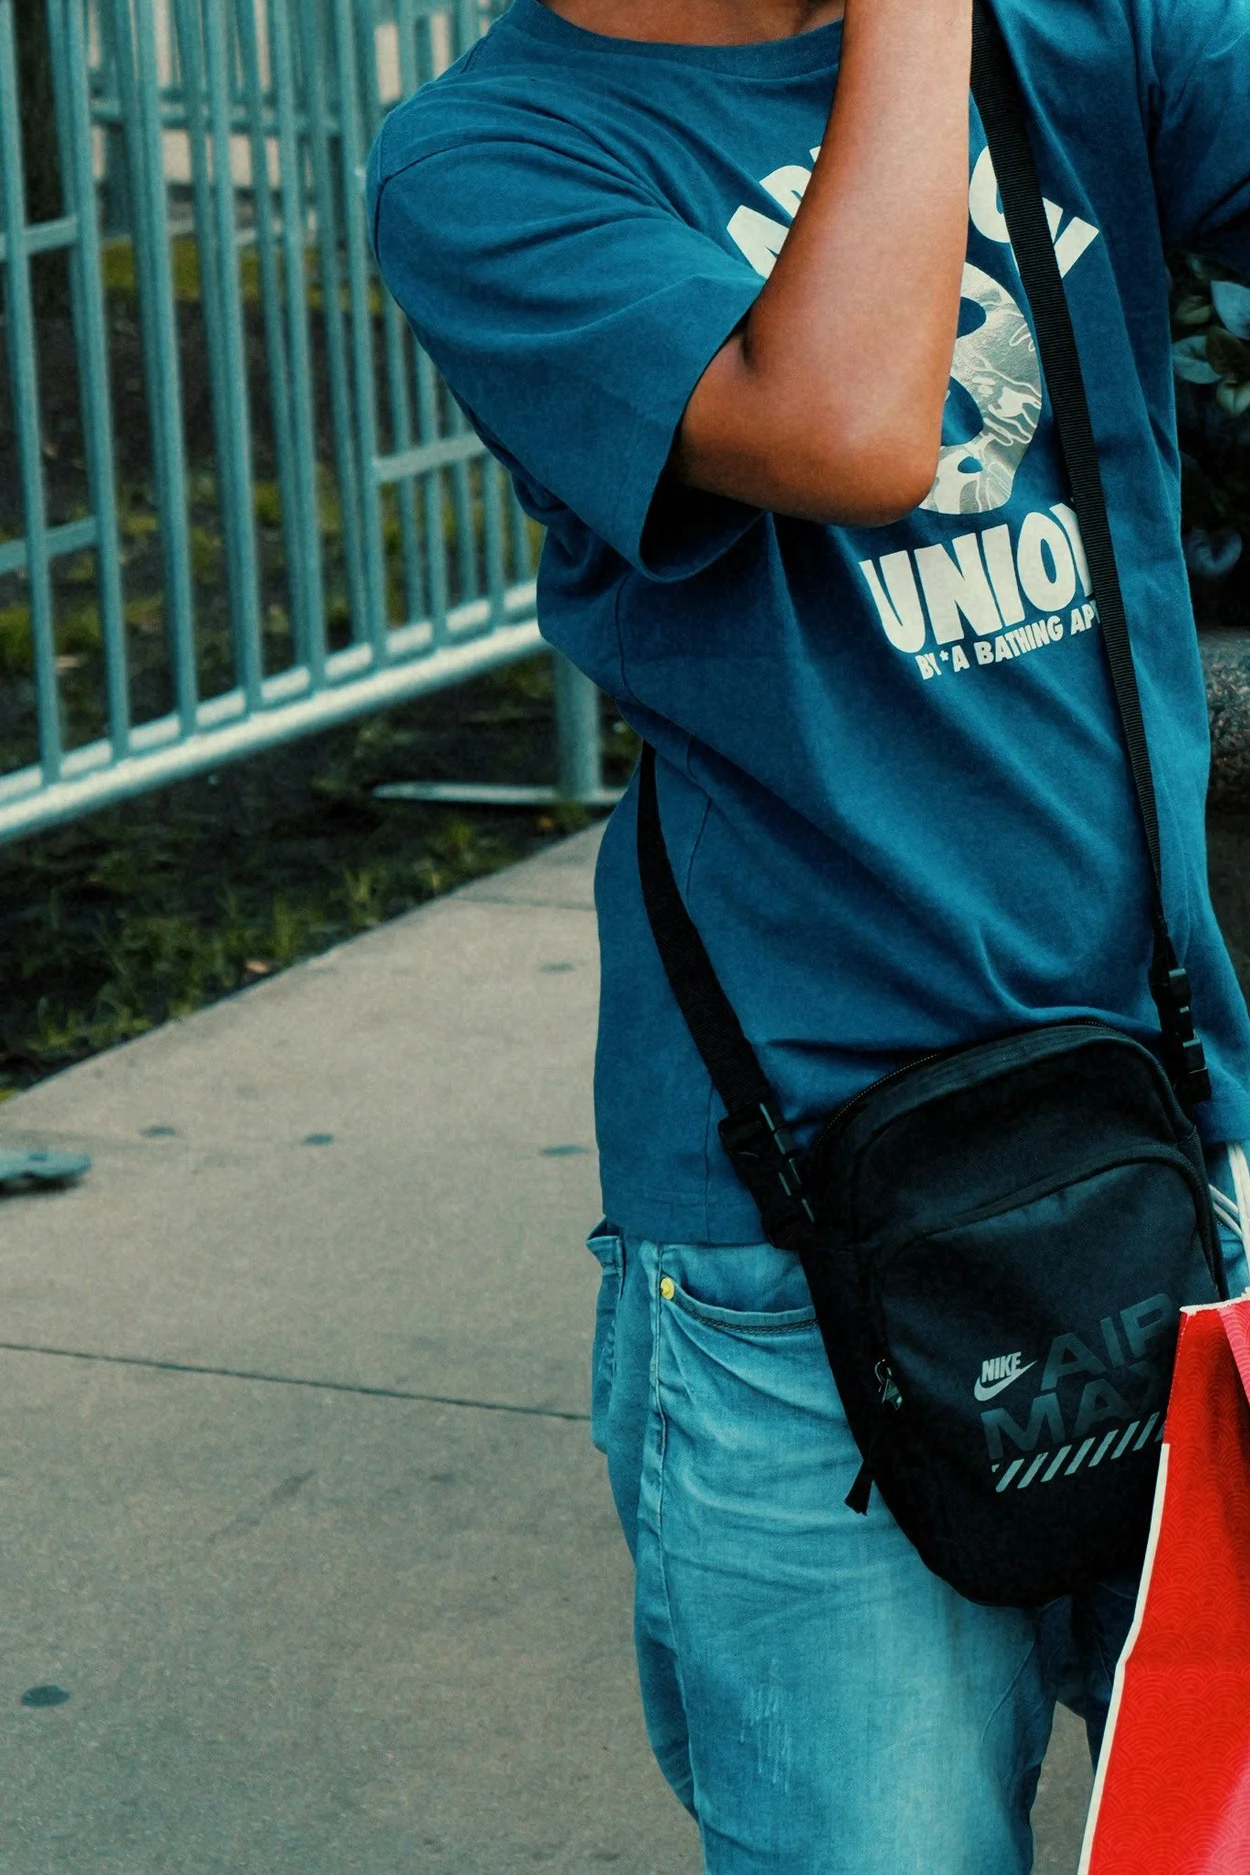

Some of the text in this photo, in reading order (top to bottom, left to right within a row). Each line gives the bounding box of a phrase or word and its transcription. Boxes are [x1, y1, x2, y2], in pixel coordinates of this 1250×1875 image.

[915, 652, 942, 680] BY
[974, 615, 1064, 666] BATHING
[981, 1351, 1022, 1383] NIKE
